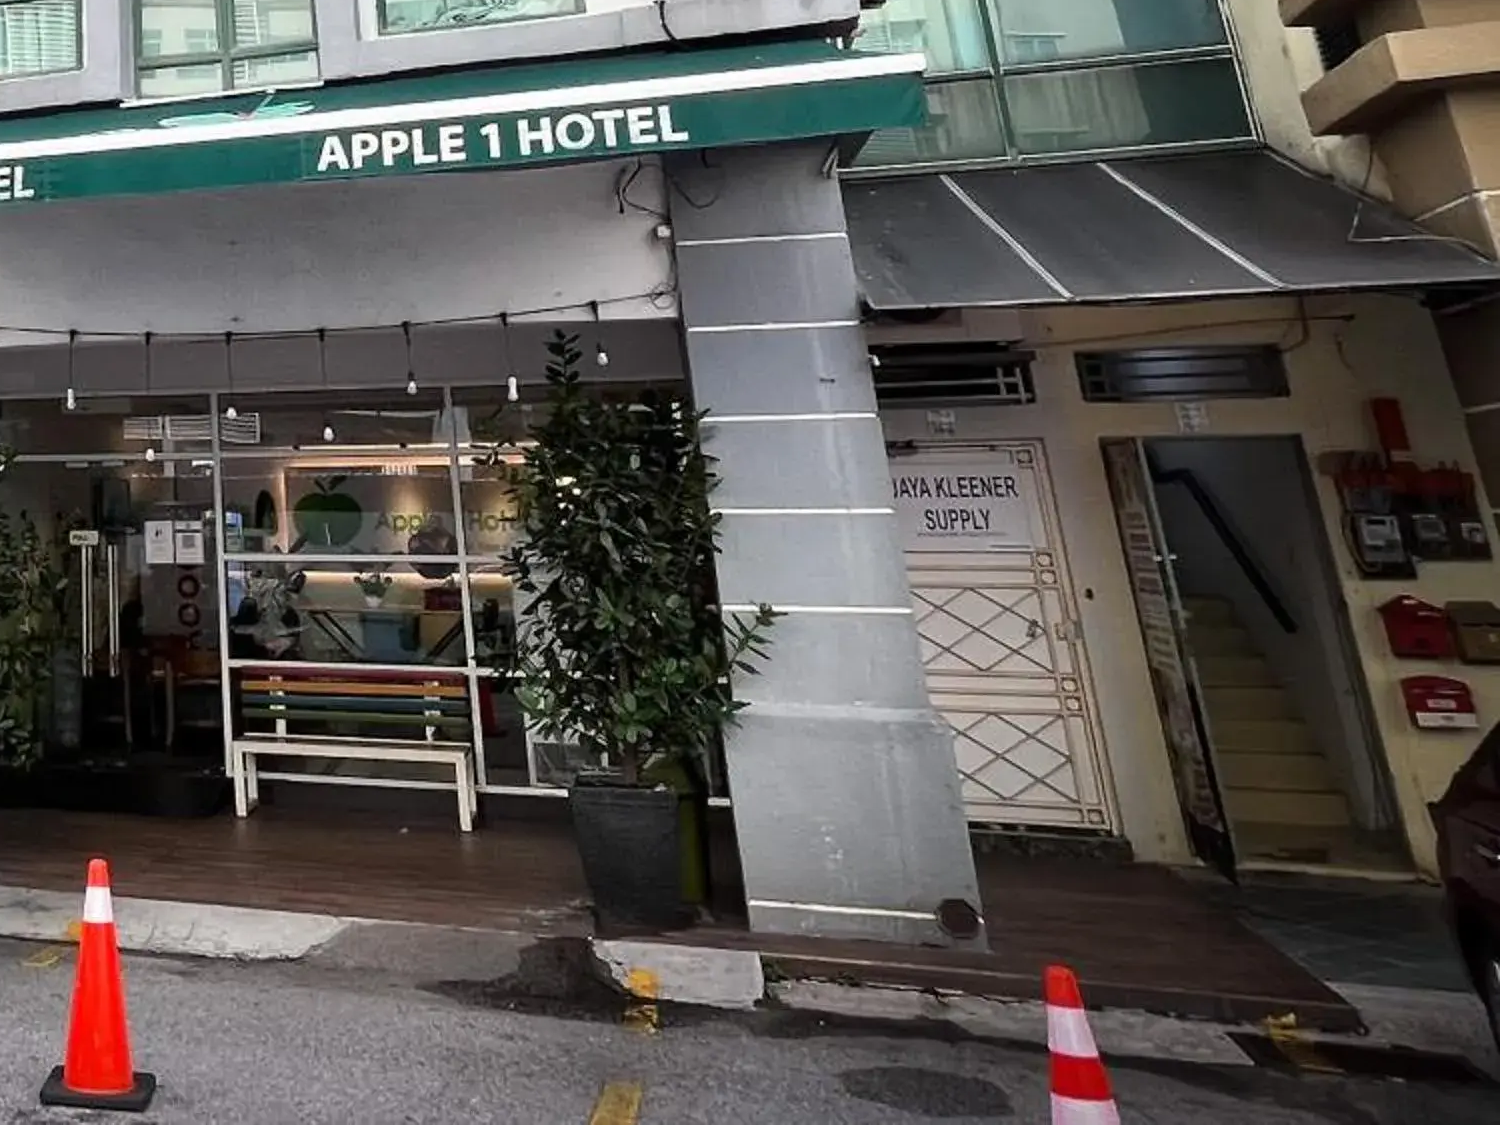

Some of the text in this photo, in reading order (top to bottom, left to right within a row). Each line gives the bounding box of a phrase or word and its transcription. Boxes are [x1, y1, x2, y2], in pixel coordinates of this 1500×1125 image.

[317, 104, 689, 172] APPLE 1 HOTEL
[934, 475, 1020, 499] KLEENER
[466, 508, 526, 532] Hot
[923, 508, 991, 532] SUPPLY
